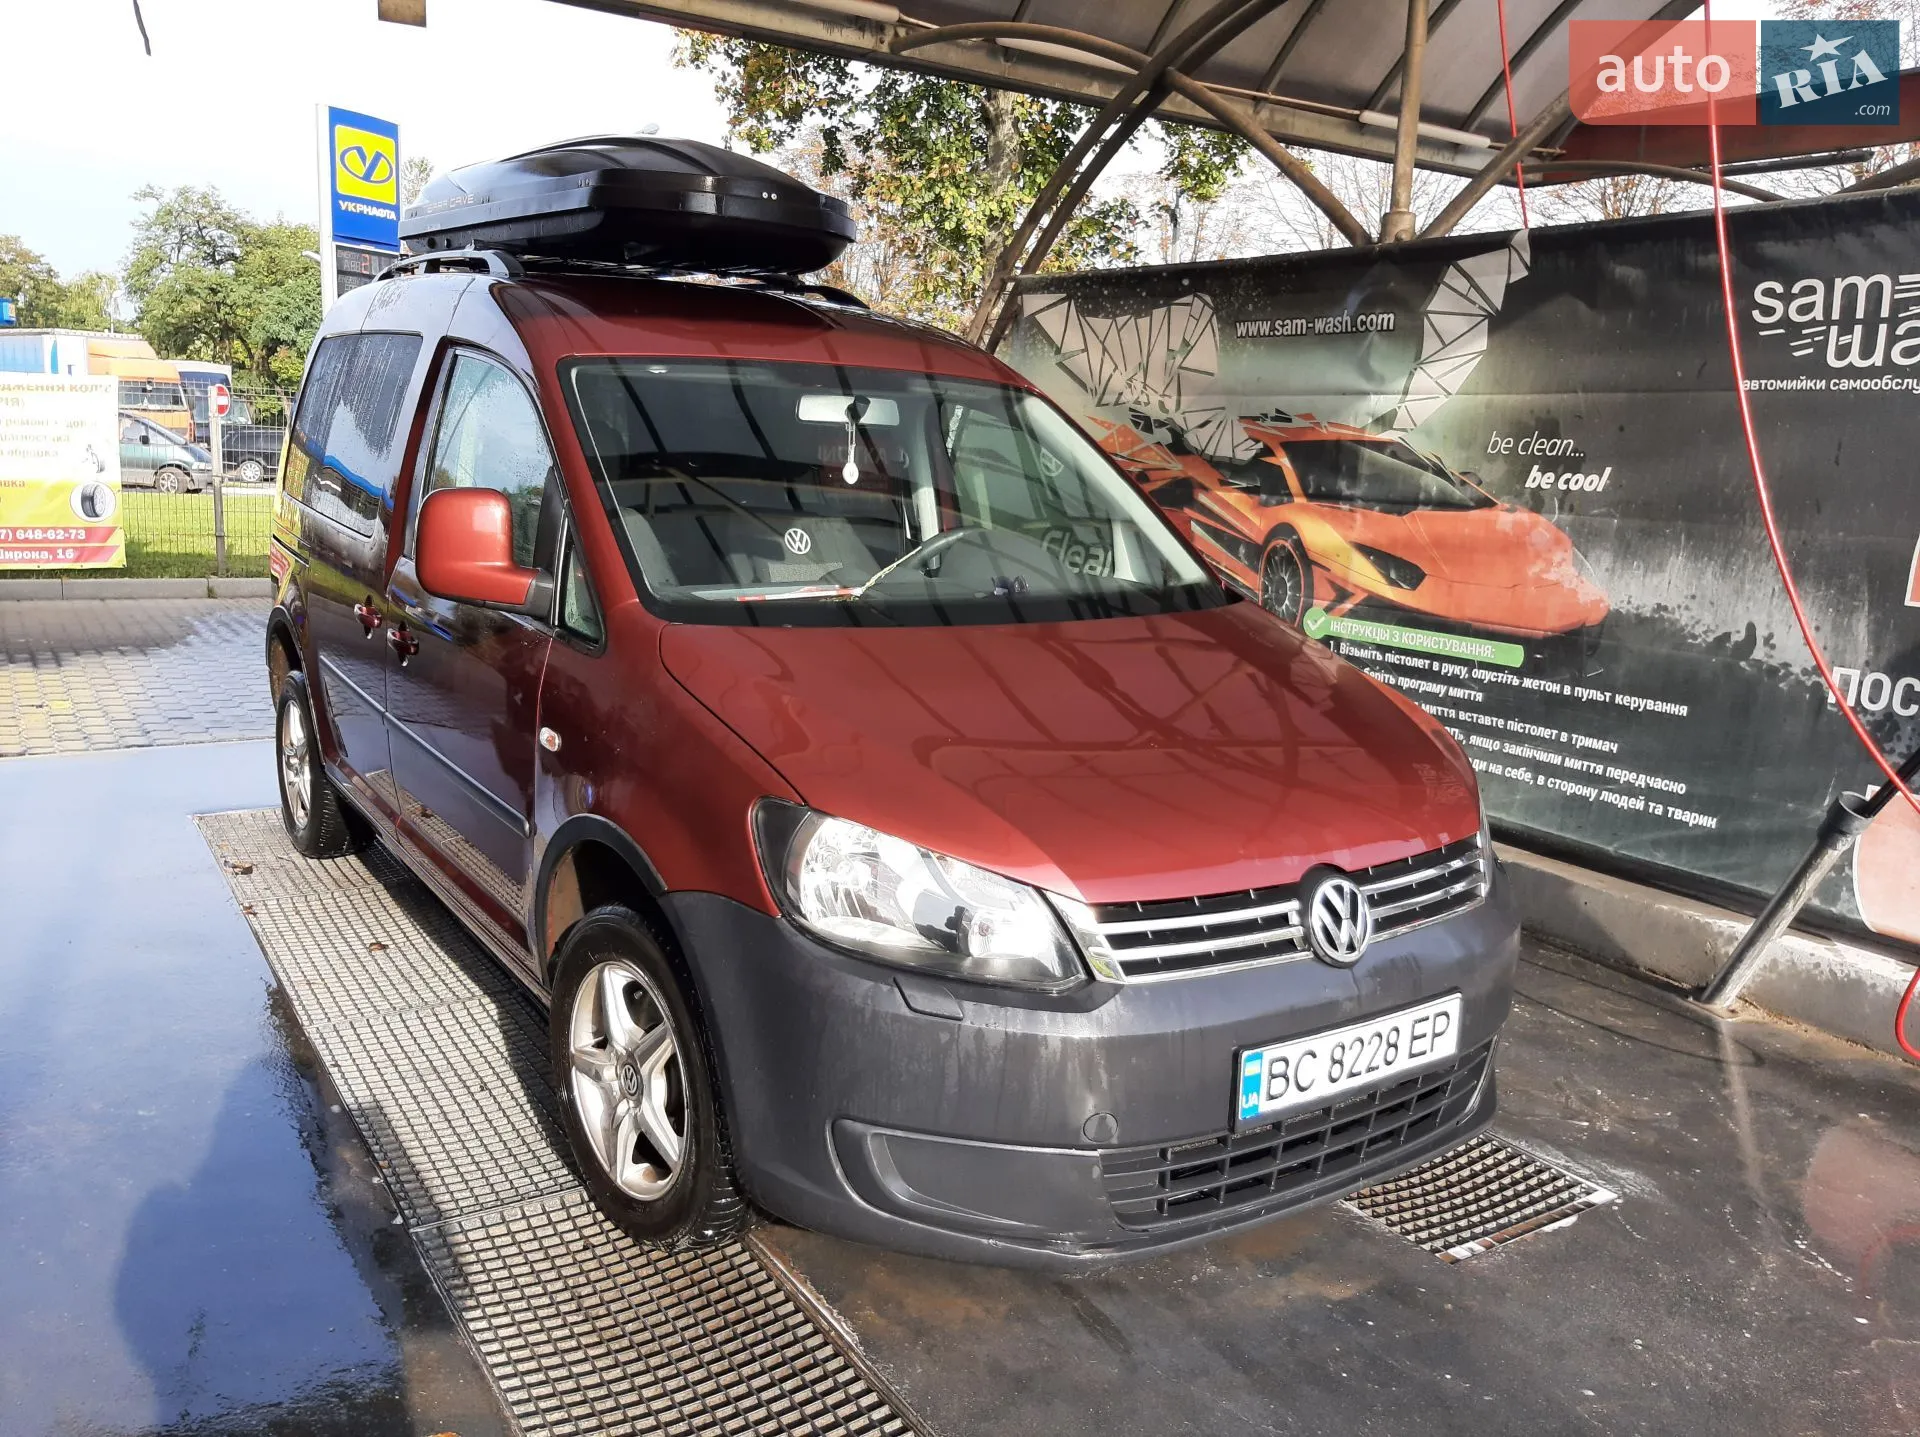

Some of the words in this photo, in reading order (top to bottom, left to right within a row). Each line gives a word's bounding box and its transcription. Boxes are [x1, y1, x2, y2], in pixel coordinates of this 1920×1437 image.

[338, 199, 397, 221] УКРНАФТА
[1751, 273, 1892, 324] sam
[1236, 310, 1395, 338] www.sam-wash.com
[1743, 375, 1826, 391] автомийки
[1487, 431, 1514, 455] be
[1518, 430, 1585, 457] clean...
[1525, 465, 1556, 489] be
[1557, 467, 1612, 492] cool
[1402, 632, 1496, 658] КОРИСТУВАННЯ:
[1329, 640, 1338, 653] 1.
[1340, 642, 1383, 661] Візьміть
[1385, 650, 1430, 669] пістолет
[1432, 661, 1439, 671] в
[1441, 663, 1469, 679] руку,
[1472, 669, 1519, 686] опустіть
[1522, 676, 1560, 694] жетон
[1563, 685, 1571, 695] в
[1574, 687, 1613, 703] пульт
[1615, 692, 1688, 717] керування
[1397, 677, 1447, 697] програму
[1448, 686, 1483, 703] миття
[1458, 711, 1505, 728] вставте
[1507, 718, 1558, 740] пістолет
[1560, 731, 1568, 742] в
[1571, 732, 1619, 754] тримач
[1469, 734, 1501, 753] якщо
[1503, 741, 1562, 765] закінчили
[1564, 756, 1604, 776] миття
[1606, 766, 1687, 796] передчасно
[1488, 762, 1503, 775] на
[1504, 766, 1534, 786] себе,
[1537, 776, 1545, 786] в
[1547, 778, 1598, 802] сторону
[1599, 790, 1645, 812] людей
[1648, 801, 1663, 816] та
[1667, 805, 1718, 829] тварин
[1266, 1049, 1318, 1101] BC
[1328, 1025, 1400, 1084] 8228
[1408, 1010, 1451, 1060] EP
[1242, 1092, 1259, 1109] UA
